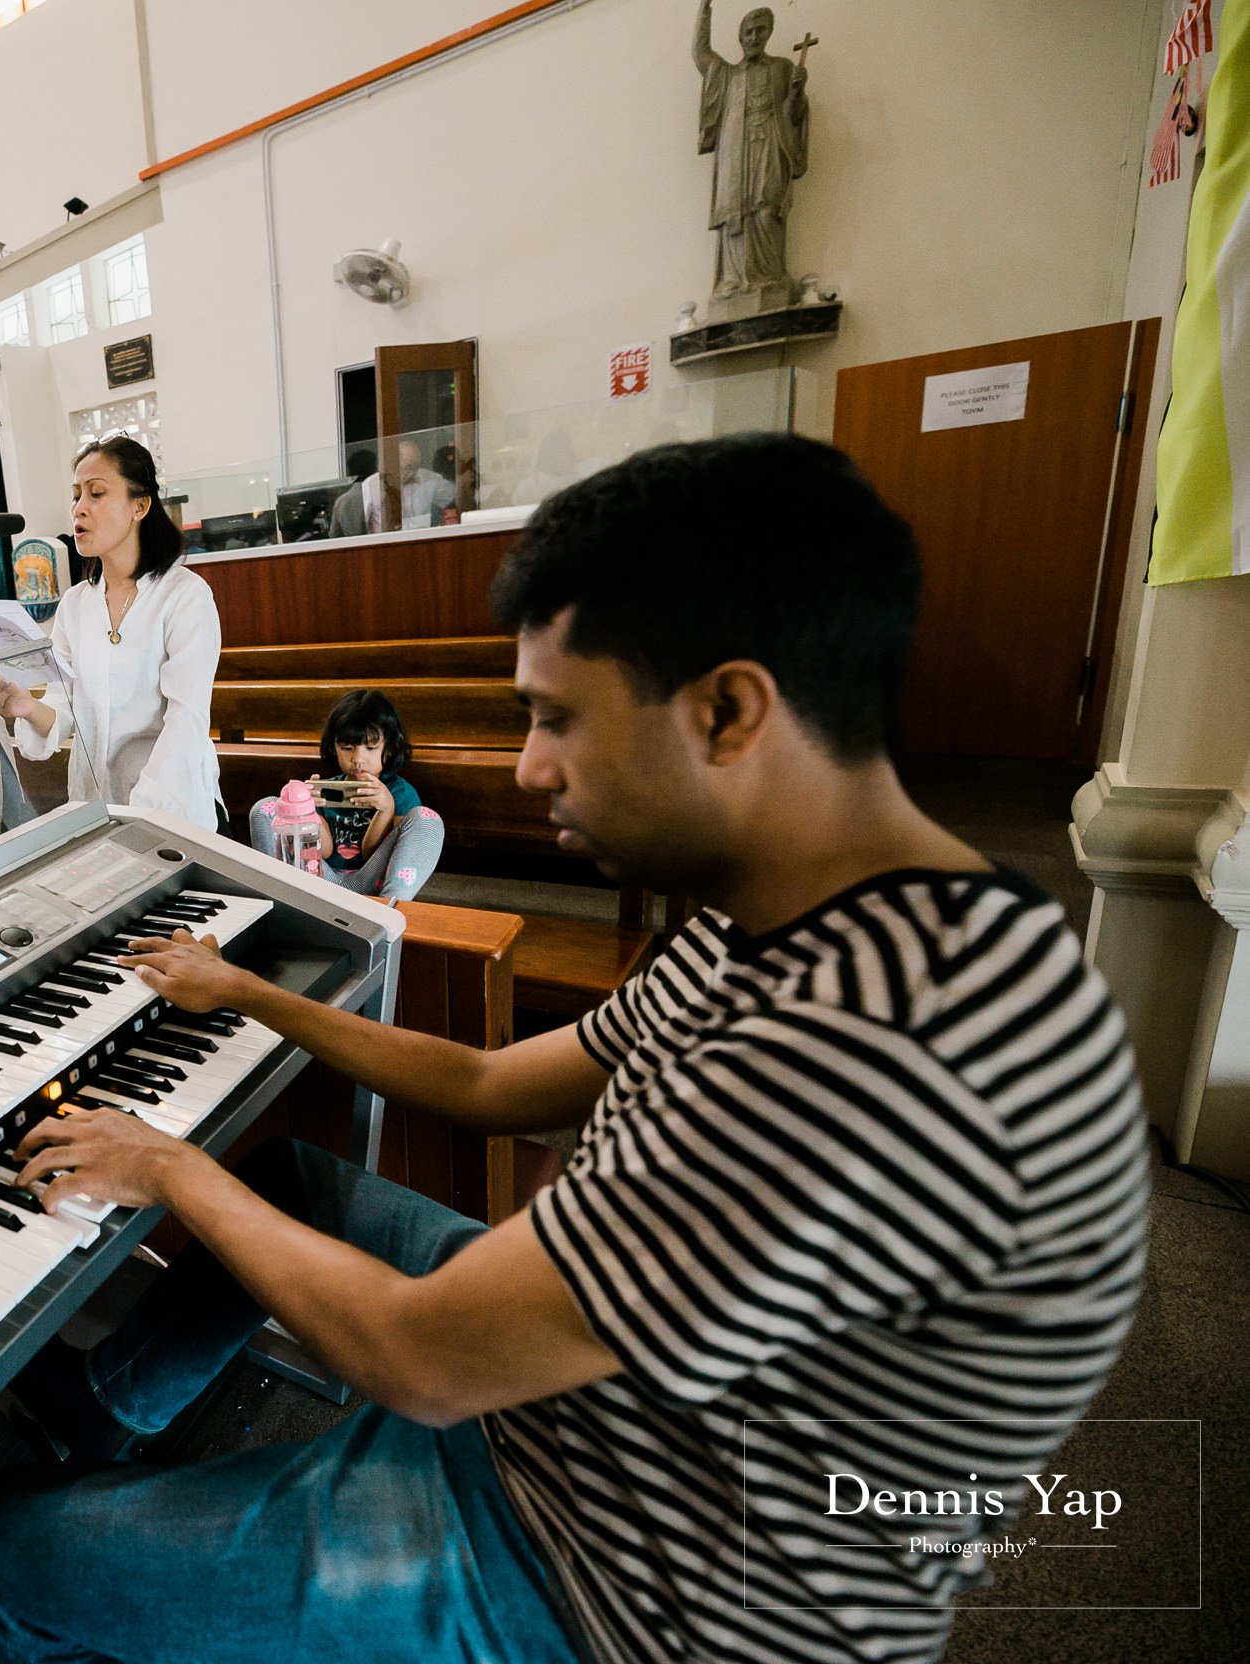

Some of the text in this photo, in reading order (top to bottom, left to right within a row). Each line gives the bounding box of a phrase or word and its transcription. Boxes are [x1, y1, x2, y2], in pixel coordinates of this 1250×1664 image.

[615, 353, 645, 369] FIRE
[941, 389, 967, 398] PLEASE
[968, 386, 991, 394] CLOSE
[972, 394, 1000, 403] GENTLY
